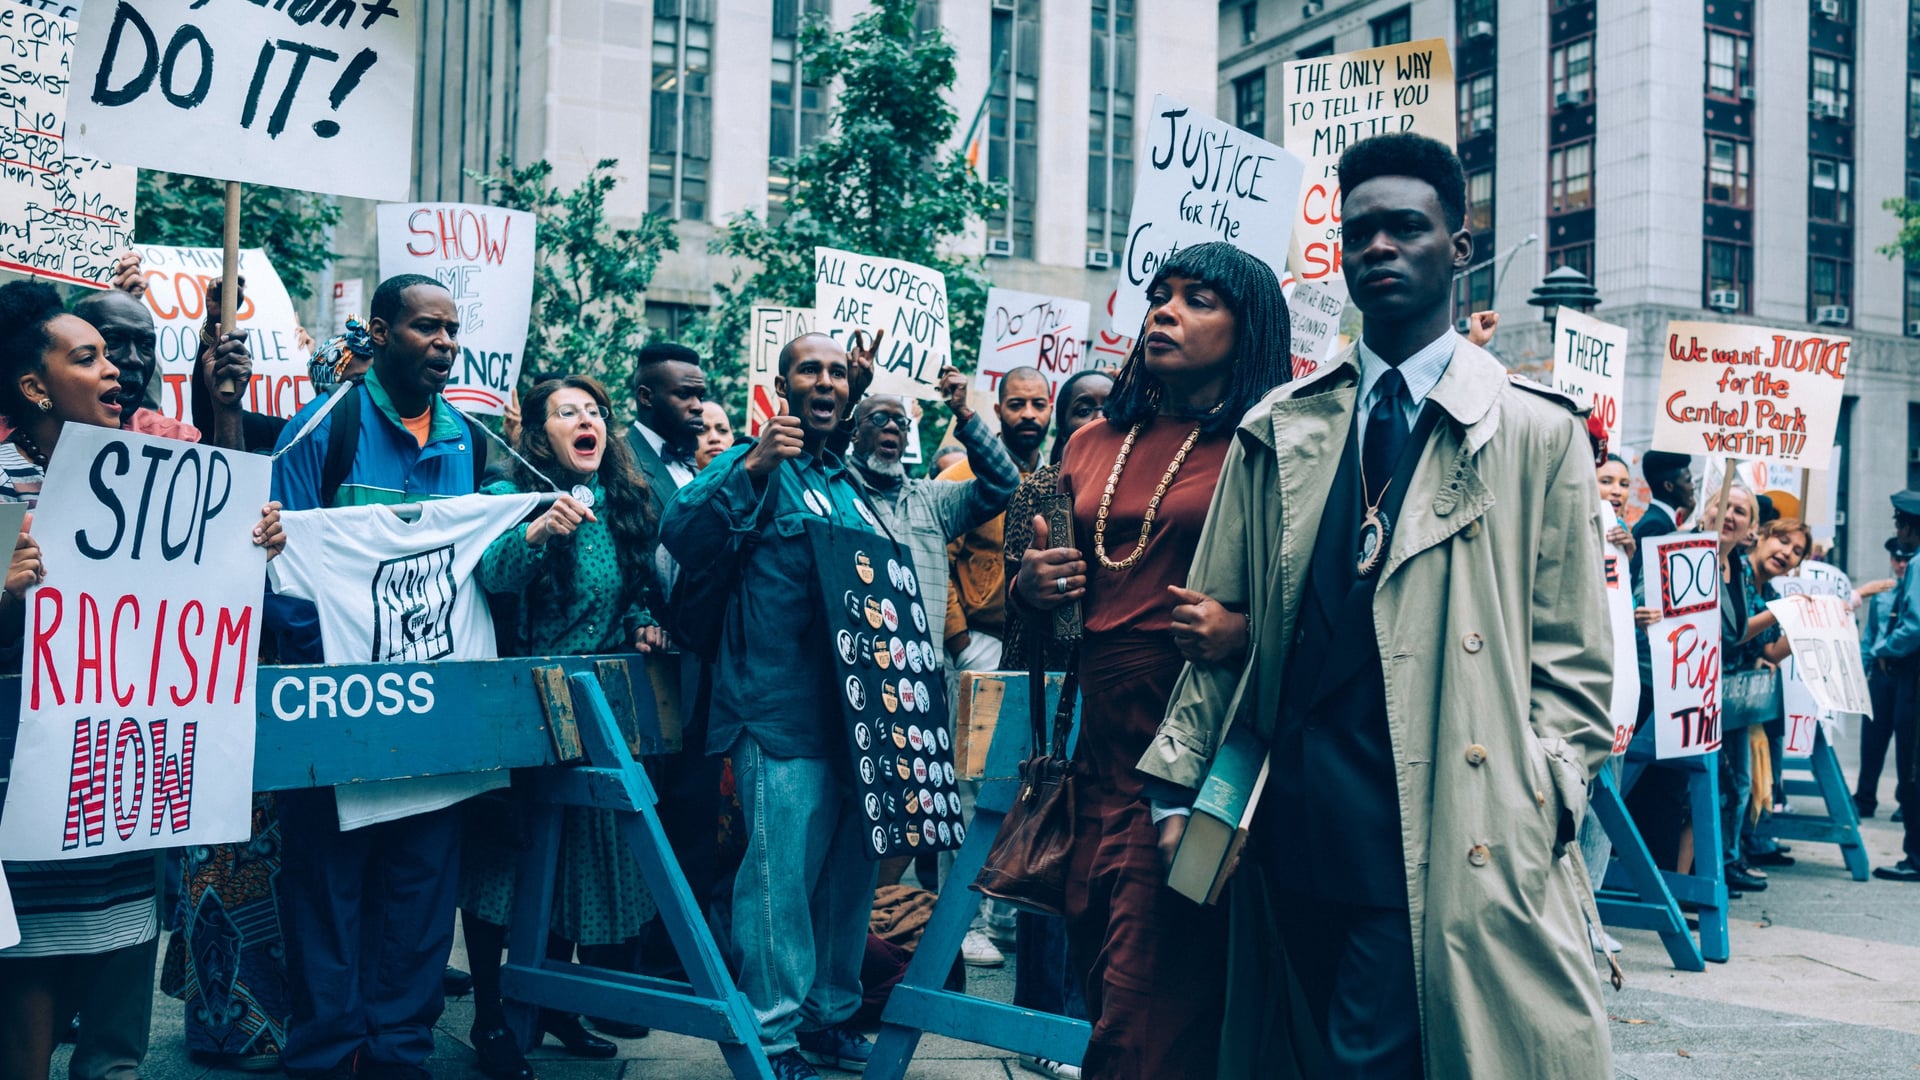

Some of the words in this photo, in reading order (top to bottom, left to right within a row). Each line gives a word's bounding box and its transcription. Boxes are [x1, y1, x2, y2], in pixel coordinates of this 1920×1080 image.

[23, 13, 77, 46] rank
[60, 51, 70, 72] A
[91, 1, 213, 109] DO
[240, 39, 378, 140] IT!
[1294, 63, 1332, 94] THE
[1340, 60, 1385, 90] ONLY
[1397, 51, 1432, 81] WAY
[1289, 101, 1314, 126] TO
[1322, 97, 1359, 120] TELL
[1367, 91, 1385, 110] IF
[1394, 84, 1429, 108] YOU
[406, 208, 511, 266] SHOW
[1211, 200, 1240, 241] the
[816, 255, 846, 287] ALL
[855, 263, 945, 321] SUSPECTS
[833, 296, 873, 325] ARE
[892, 306, 944, 347] NOT
[996, 306, 1023, 342] Do
[1565, 328, 1615, 378] THERE
[1669, 333, 1707, 363] We
[1712, 346, 1763, 366] want
[1765, 335, 1850, 380] JUSTICE
[1717, 366, 1749, 394] for
[1753, 371, 1789, 399] the
[1666, 390, 1748, 428] Central
[1755, 399, 1807, 433] Park
[1779, 433, 1807, 460] !!!
[75, 440, 231, 565] STOP
[1670, 550, 1716, 606] DO
[30, 586, 252, 711] RACISM
[271, 671, 435, 722] CROSS
[62, 716, 198, 851] NOW
